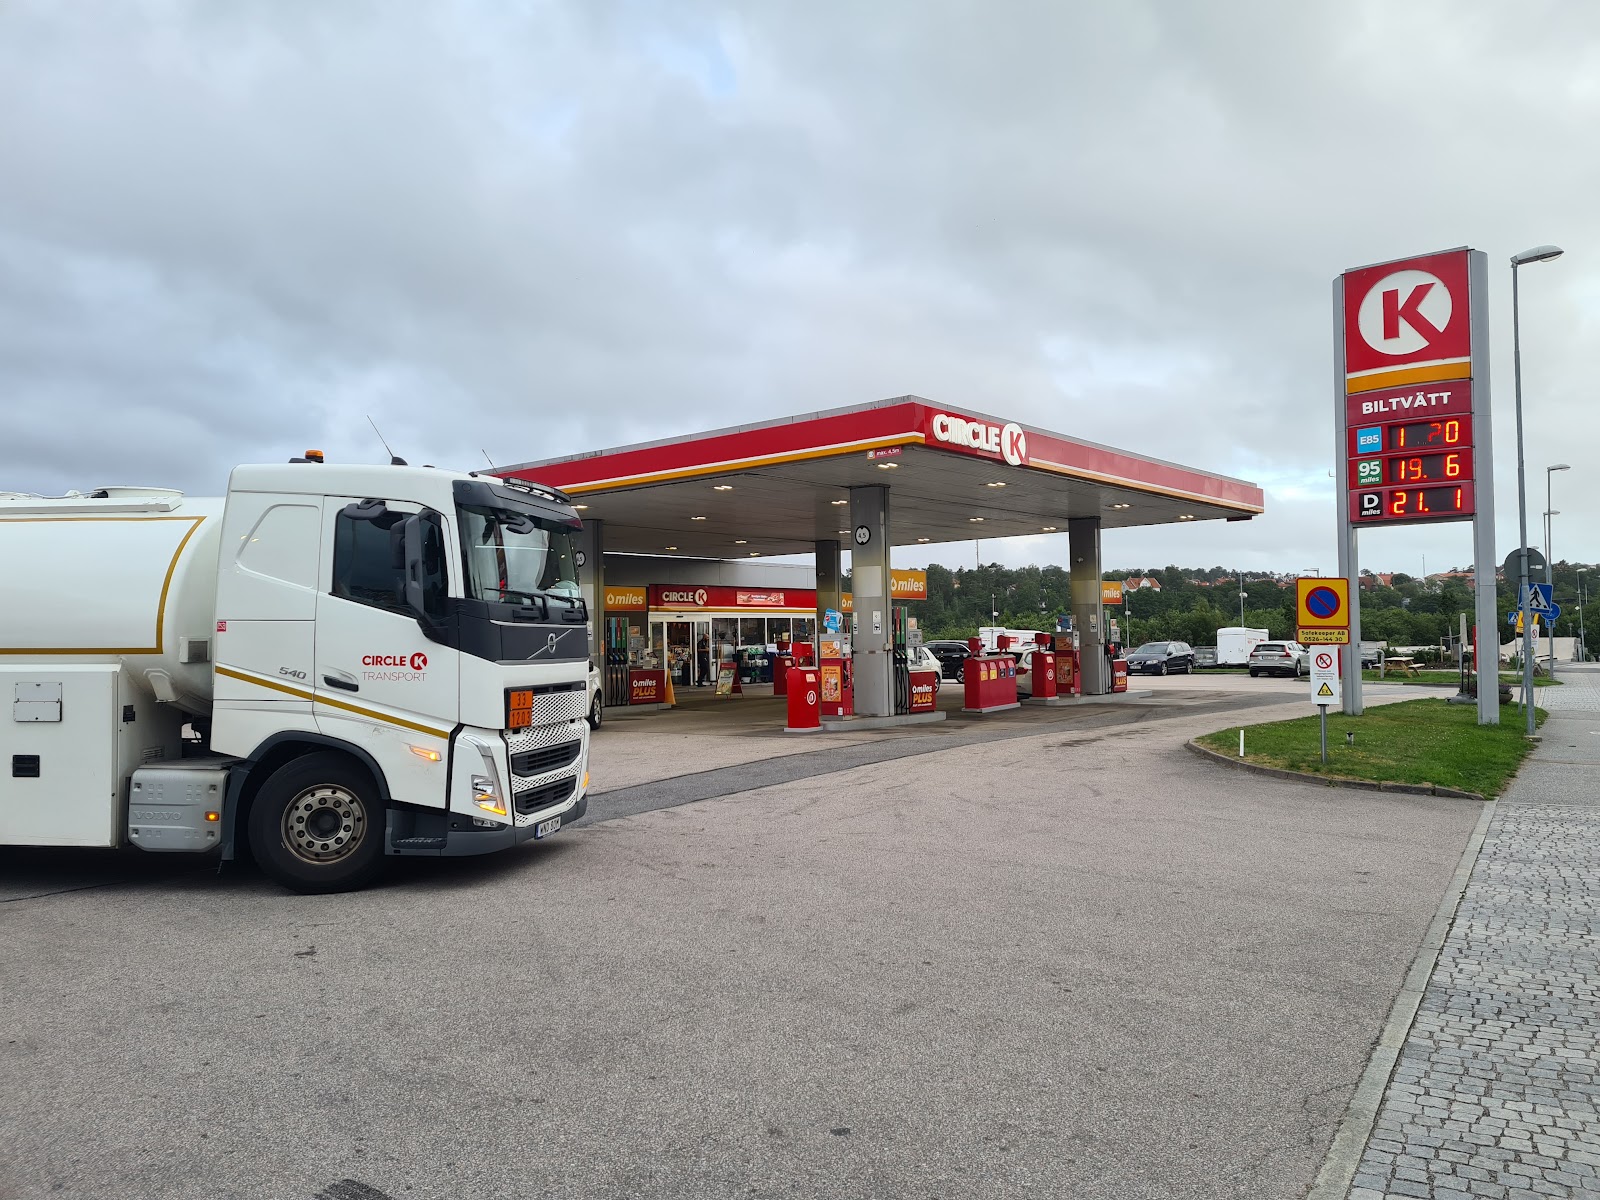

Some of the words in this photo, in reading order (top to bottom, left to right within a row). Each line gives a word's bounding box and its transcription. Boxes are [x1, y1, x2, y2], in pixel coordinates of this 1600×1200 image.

[1379, 280, 1445, 347] K
[1362, 391, 1452, 415] BILTVÄTT
[932, 413, 1000, 453] CIRCLE
[1007, 428, 1026, 465] K
[1359, 434, 1379, 445] E85
[1359, 461, 1380, 476] 95
[1360, 476, 1380, 484] miles
[1363, 494, 1379, 508] D
[1361, 508, 1381, 516] miles
[898, 578, 924, 592] miles
[615, 593, 643, 605] miles
[662, 591, 694, 602] CIRCLE
[696, 590, 707, 605] K
[1104, 588, 1120, 598] miles
[362, 655, 407, 666] CIRCLE
[411, 654, 427, 669] K
[278, 666, 307, 680] 540
[362, 671, 428, 682] TRANSPORT
[638, 679, 657, 687] miles
[916, 684, 933, 693] miles
[633, 686, 657, 697] PLUS
[517, 693, 527, 706] 33
[913, 693, 933, 704] PLUS
[511, 710, 531, 726] 1203
[133, 810, 181, 821] VOLVO
